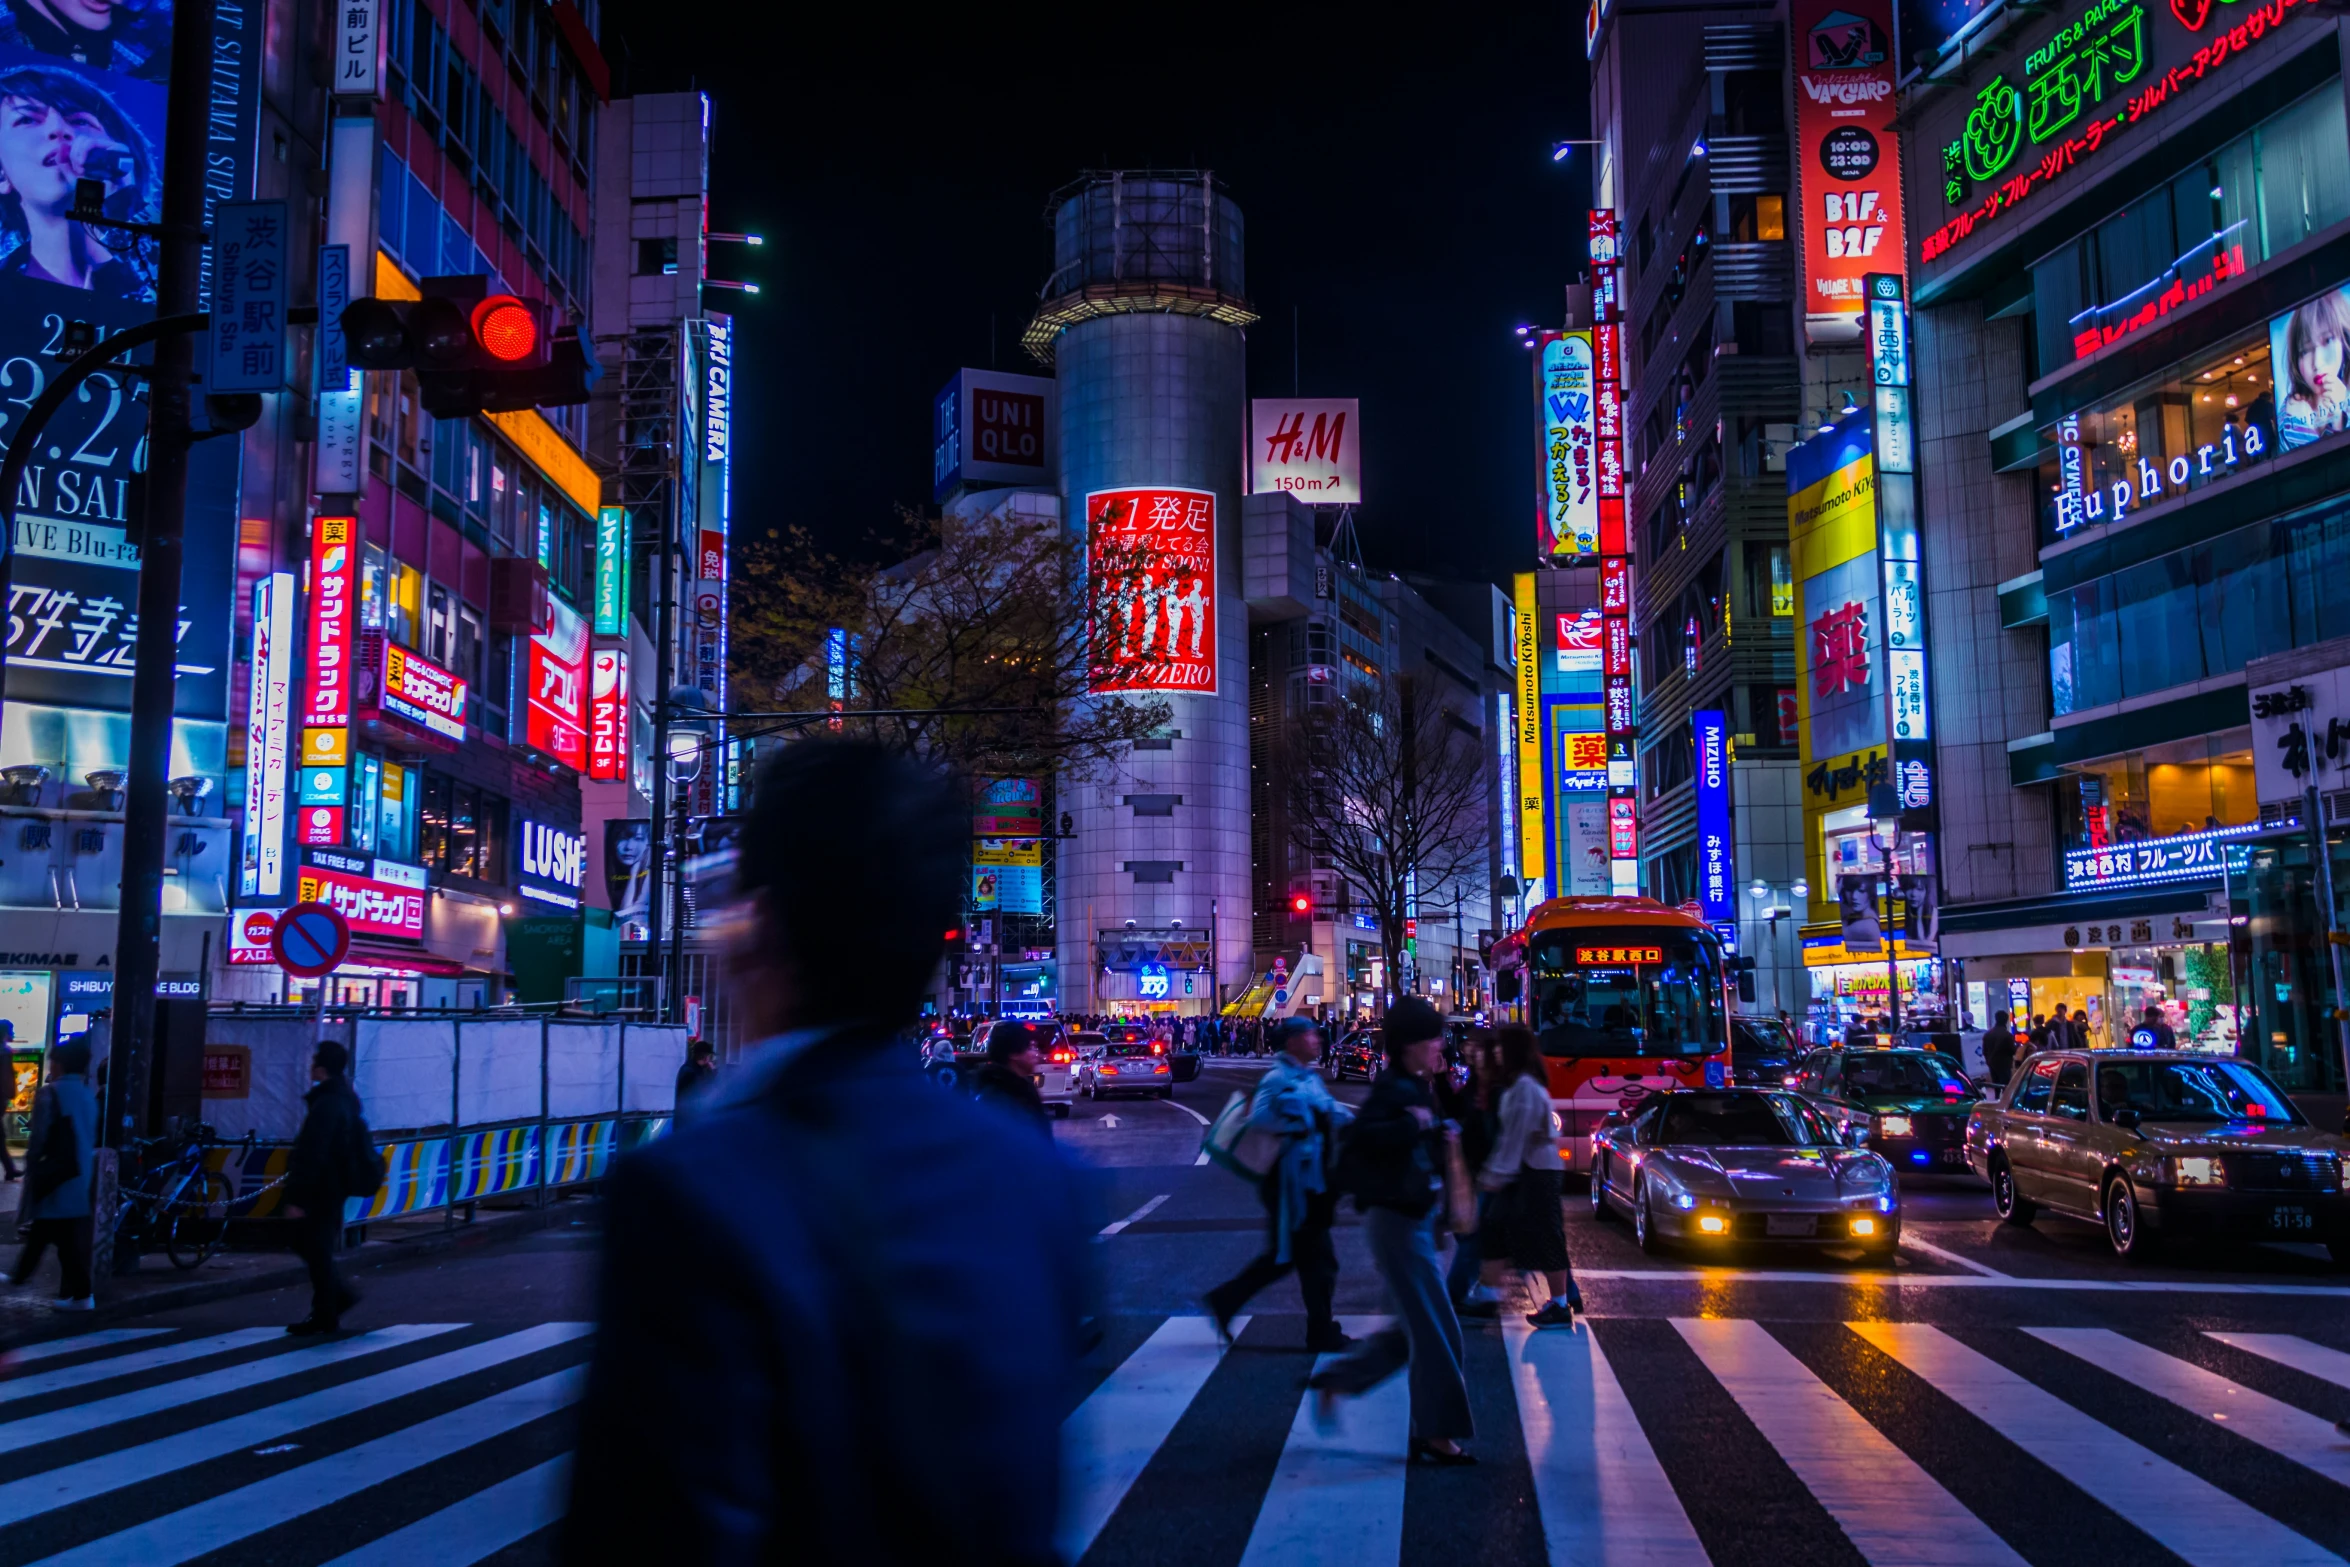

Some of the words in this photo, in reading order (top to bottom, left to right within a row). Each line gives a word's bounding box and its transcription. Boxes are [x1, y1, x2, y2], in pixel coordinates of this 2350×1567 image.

[344, 0, 369, 79] 前ビル
[2025, 28, 2073, 75] FRUITS
[2073, 21, 2084, 39] &
[209, 36, 242, 143] SAITAMA
[1800, 76, 1891, 104] VANGUARD
[2028, 5, 2143, 145] 西村
[203, 152, 236, 228] SUP
[1943, 139, 1962, 205] 渋谷
[1824, 192, 1879, 222] B1F
[1877, 208, 1888, 222] &
[1826, 226, 1883, 258] B2F
[218, 241, 241, 317] Shibuya
[242, 215, 278, 377] 渋谷駅前
[1816, 277, 1849, 297] VILLAGE
[219, 320, 239, 358] Sta.
[707, 366, 726, 461] CAMERA
[939, 390, 956, 441] THE
[980, 397, 1032, 424] UNI
[1887, 393, 1900, 457] Euphoria
[934, 426, 960, 489] PRIME
[980, 427, 1037, 458] QLO
[1265, 411, 1347, 465] H&M
[1274, 475, 1323, 491] 150m
[2053, 423, 2264, 532] Euphoria
[1145, 496, 1210, 533] 発足
[1794, 491, 1851, 527] Matsumoto
[14, 520, 58, 553] IVE
[67, 527, 140, 563] Blu-ra
[325, 522, 345, 541] 薬
[1161, 553, 1210, 573] SOON!
[1903, 579, 1917, 623] フルーツ
[316, 576, 345, 712] サンドラッグ
[1520, 612, 1533, 663] KiYoshi
[1610, 620, 1621, 628] 6F
[1812, 600, 1869, 699] 薬
[541, 656, 578, 717] アコム
[1522, 663, 1535, 744] Matsumoto
[1612, 678, 1624, 686] 6F
[1895, 675, 1908, 719] フルーツ
[1909, 669, 1921, 715] 渋谷西村
[595, 703, 614, 753] アコム
[265, 682, 286, 822] マイアミガデン
[596, 758, 610, 768] 3F
[1572, 735, 1606, 768] 薬
[1705, 726, 1720, 788] MIZUHO
[1524, 797, 1540, 811] 薬
[1564, 776, 1607, 790] マツモトキ
[1903, 760, 1930, 808] HUB
[24, 825, 207, 857] 駅前ル
[312, 852, 327, 864] TAX
[328, 854, 345, 868] FREE
[346, 857, 365, 872] SHOP
[523, 820, 581, 887] LUSH
[1707, 834, 1723, 902] みずほ銀行
[2071, 853, 2132, 878] 渋谷西村
[333, 884, 404, 924] サンドラッグ
[243, 950, 267, 961] 入口
[1579, 948, 1660, 963] 渋谷駅西口
[69, 980, 114, 993] SHIBUY
[169, 982, 200, 994] BLDG
[1140, 980, 1169, 999] 109
[2272, 1213, 2313, 1229] 51-58
